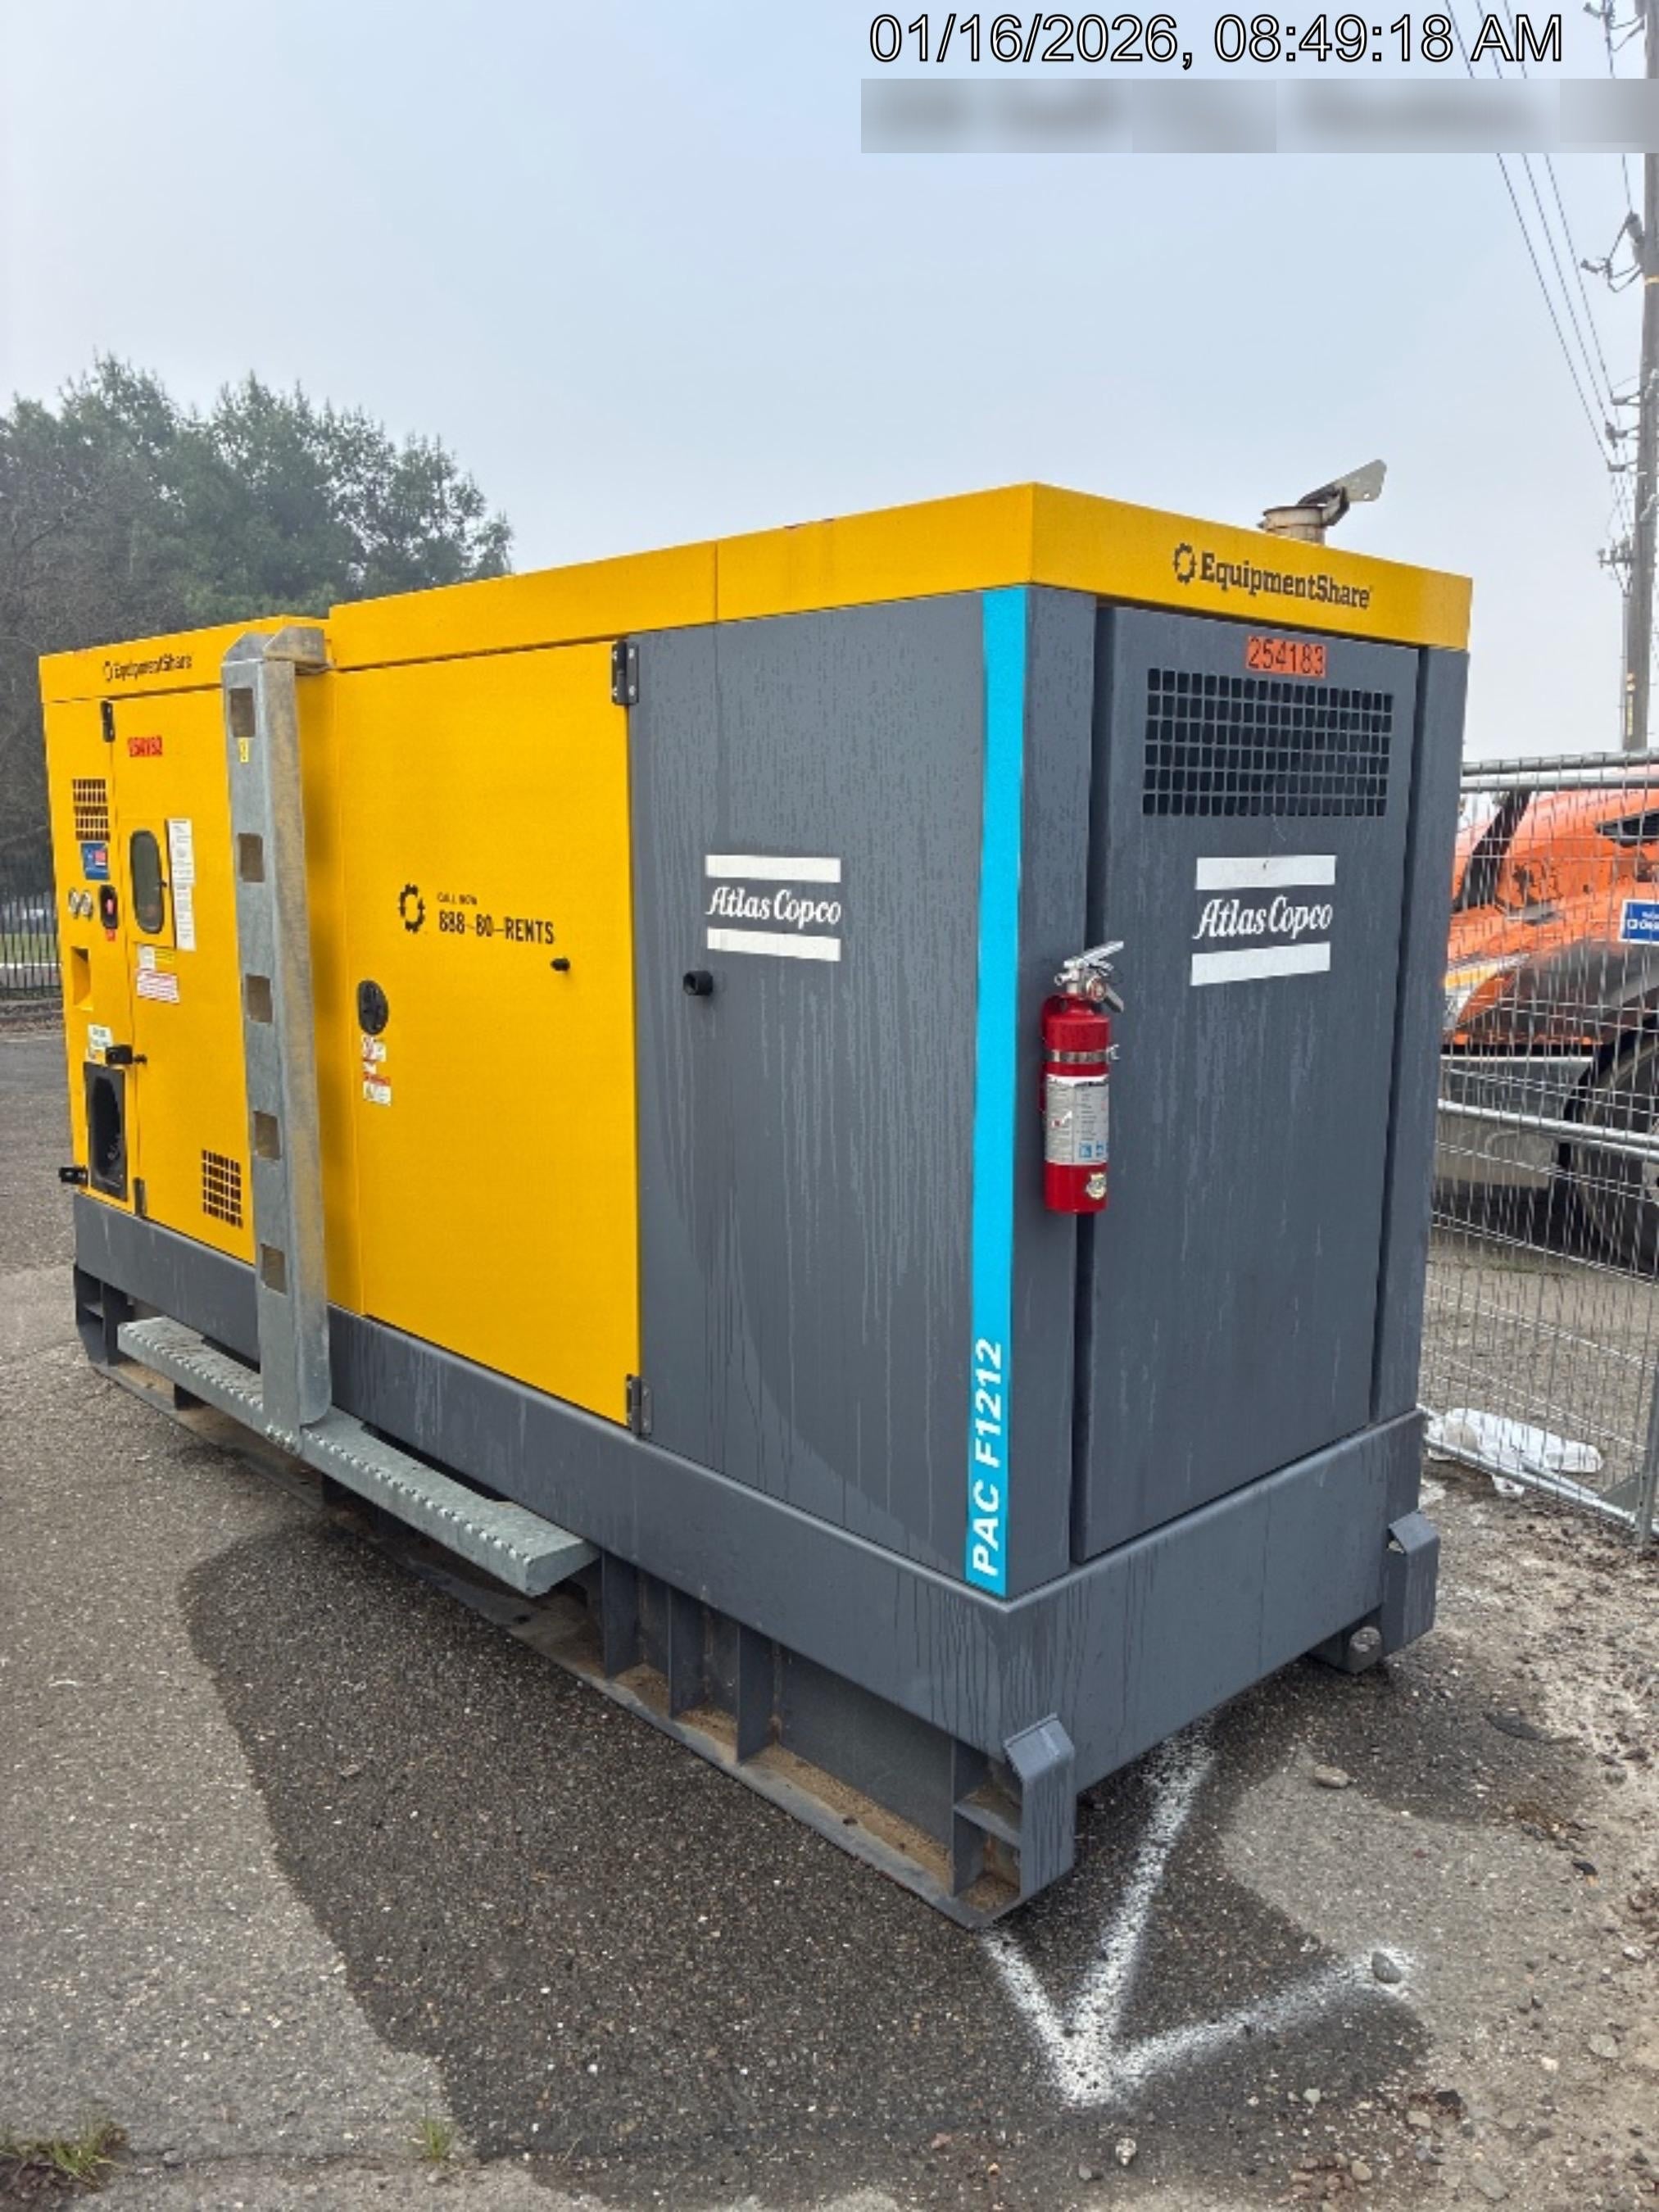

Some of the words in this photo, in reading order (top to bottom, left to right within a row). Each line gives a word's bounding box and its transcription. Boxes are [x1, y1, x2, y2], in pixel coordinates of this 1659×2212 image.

[1199, 550, 1370, 610] EquipmentShare
[1248, 637, 1324, 675] 254183
[438, 909, 555, 945] 888-80-RENTS
[705, 886, 771, 920] Atlas
[773, 888, 841, 930] Copco
[1191, 898, 1267, 940] Atlas
[1269, 894, 1334, 940] Copco
[975, 1338, 1002, 1469] F1212
[972, 1480, 999, 1577] PAC
